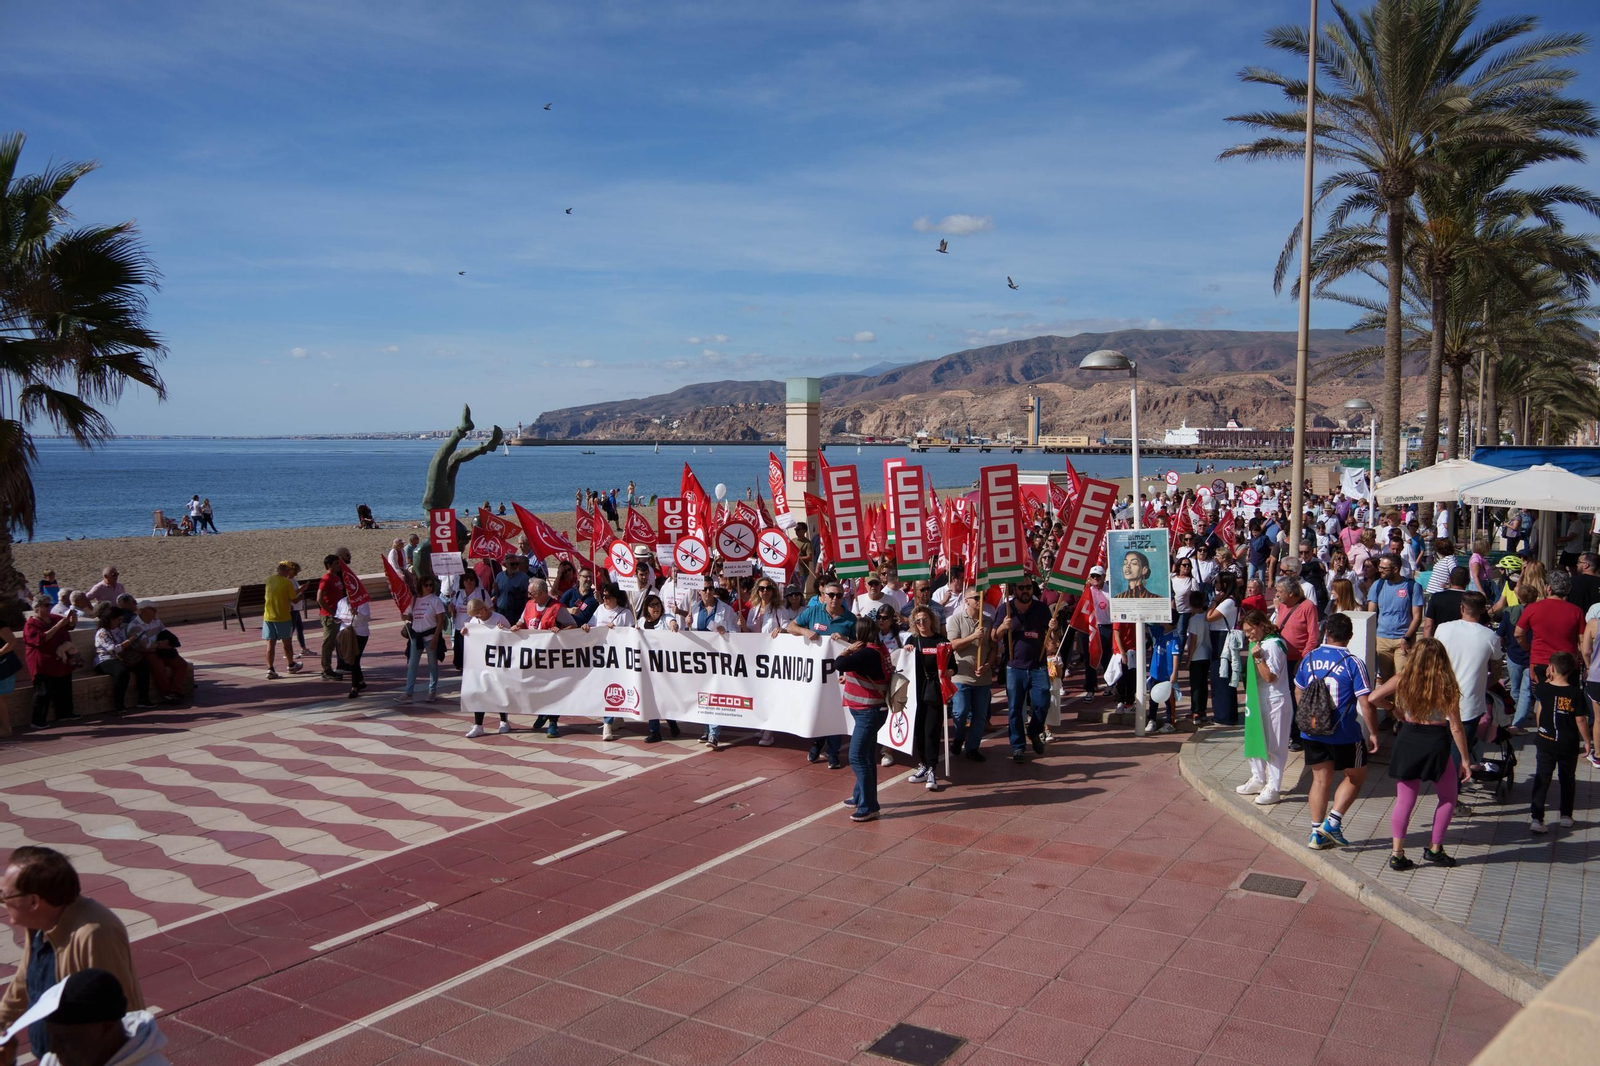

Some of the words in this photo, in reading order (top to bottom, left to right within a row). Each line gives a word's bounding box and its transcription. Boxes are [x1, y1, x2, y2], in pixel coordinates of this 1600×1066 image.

[829, 470, 861, 559] CCOO
[896, 470, 923, 561] CCOO
[987, 469, 1017, 564] CCOO
[1393, 495, 1424, 503] Alhambra
[1480, 496, 1516, 506] Alhambra
[434, 511, 452, 552] UGT
[664, 500, 683, 544] UGT
[1060, 483, 1112, 576] CCOO
[477, 536, 500, 553] UGT
[1124, 541, 1151, 549] JAZZ
[485, 645, 512, 668] EN
[519, 645, 619, 669] DEFENSA
[625, 647, 642, 672] DE
[648, 649, 748, 678] NUESTRA
[821, 658, 844, 684] P
[607, 687, 623, 697] UGT
[710, 695, 741, 706] CCOO
